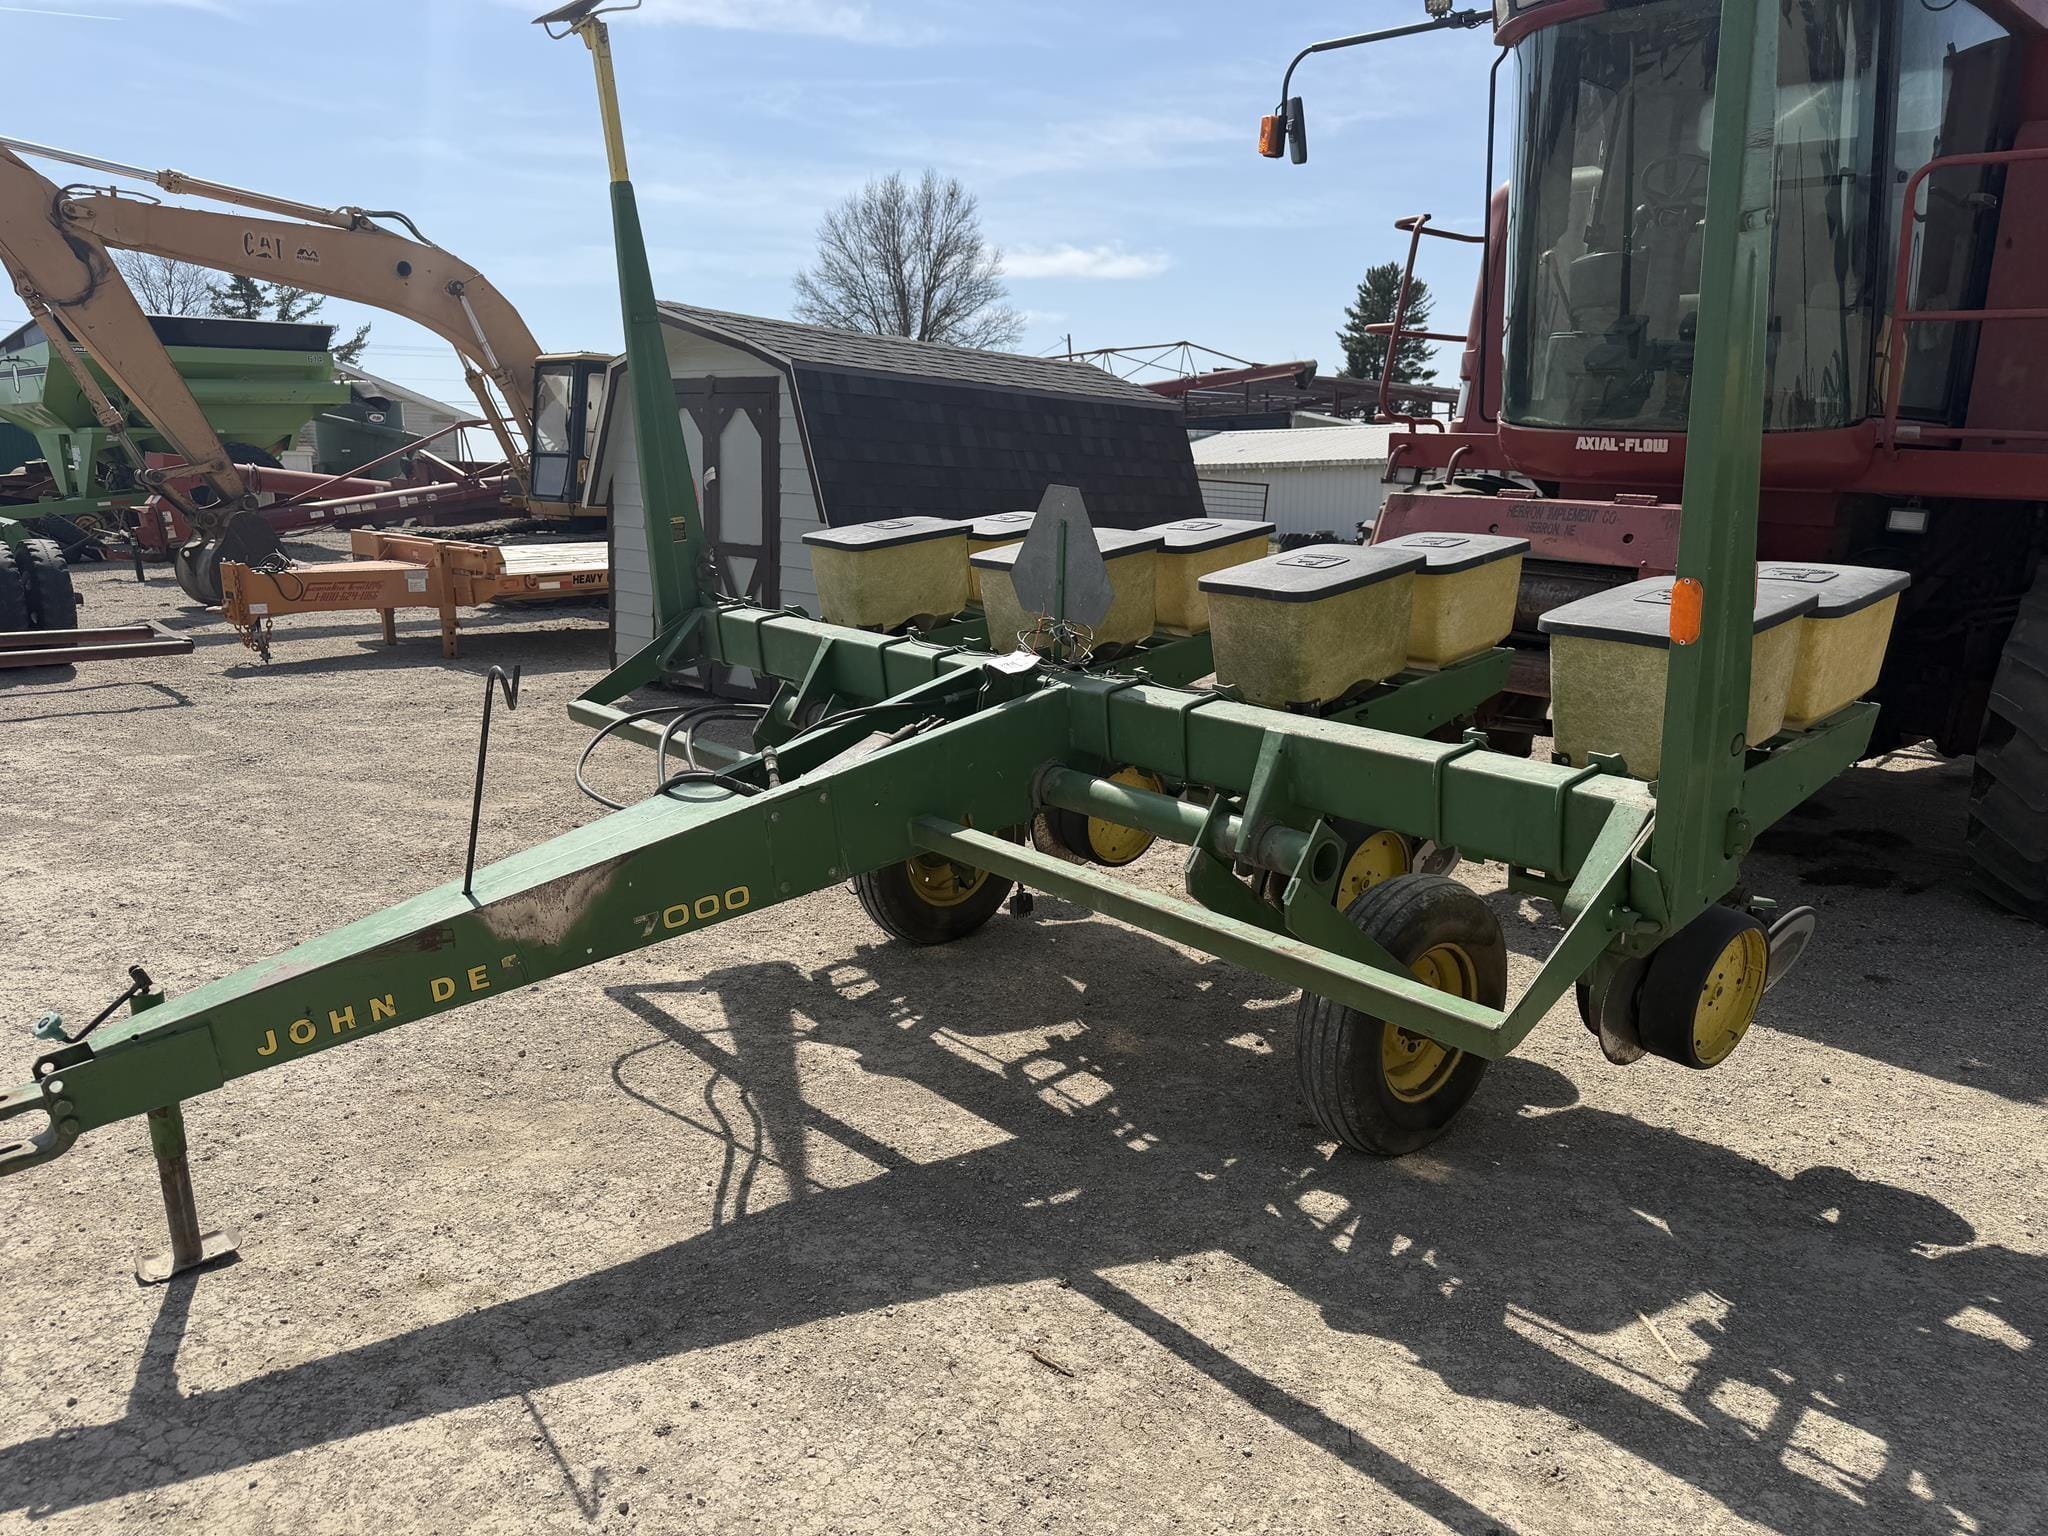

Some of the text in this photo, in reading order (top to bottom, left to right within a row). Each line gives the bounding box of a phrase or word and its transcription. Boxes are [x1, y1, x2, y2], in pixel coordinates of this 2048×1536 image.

[1575, 436, 1669, 453] AXIAL-FLOW
[572, 574, 603, 585] HEAVY
[632, 885, 751, 939] 7000
[256, 993, 397, 1056] JOHN
